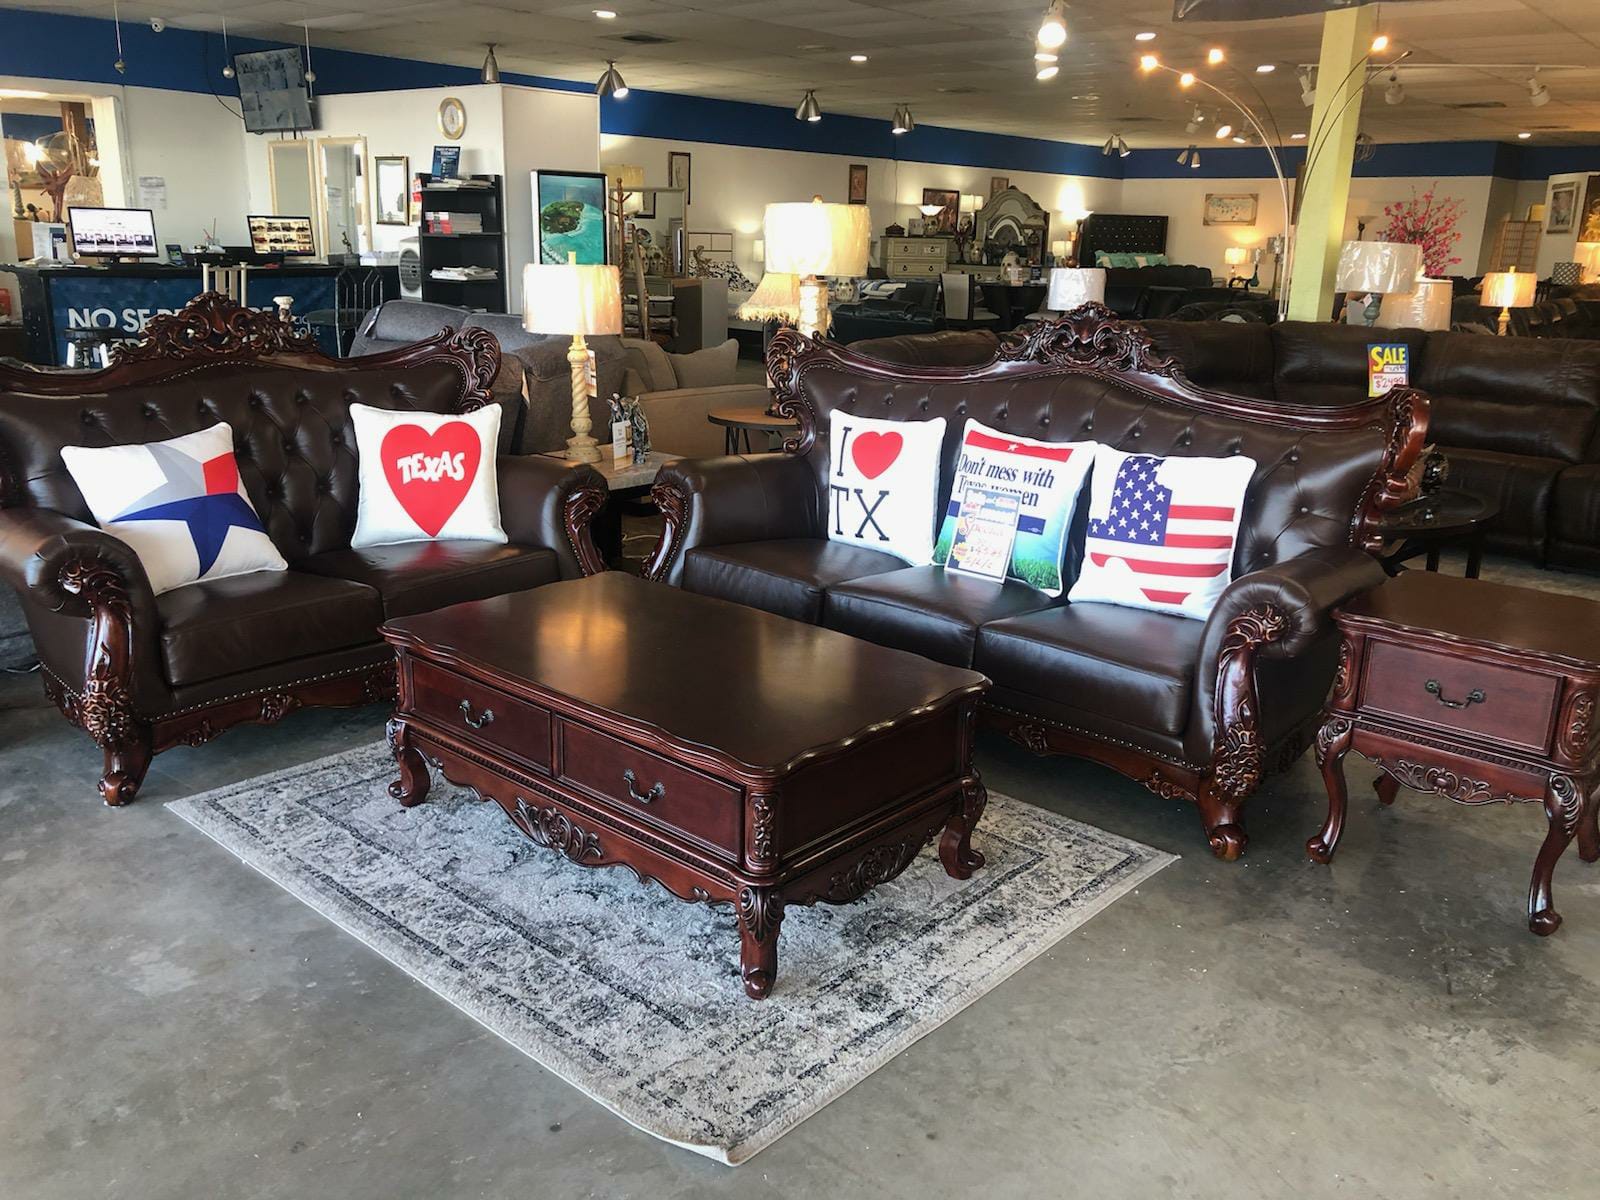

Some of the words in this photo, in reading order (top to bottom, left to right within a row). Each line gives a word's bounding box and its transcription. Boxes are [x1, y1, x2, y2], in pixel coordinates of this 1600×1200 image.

[68, 308, 117, 328] NO
[1371, 346, 1406, 371] SALE
[397, 451, 465, 484] TEXAS
[837, 426, 852, 477] I
[959, 453, 985, 475] Don't
[986, 464, 1018, 482] mess
[1023, 467, 1055, 489] with
[831, 484, 889, 541] TX
